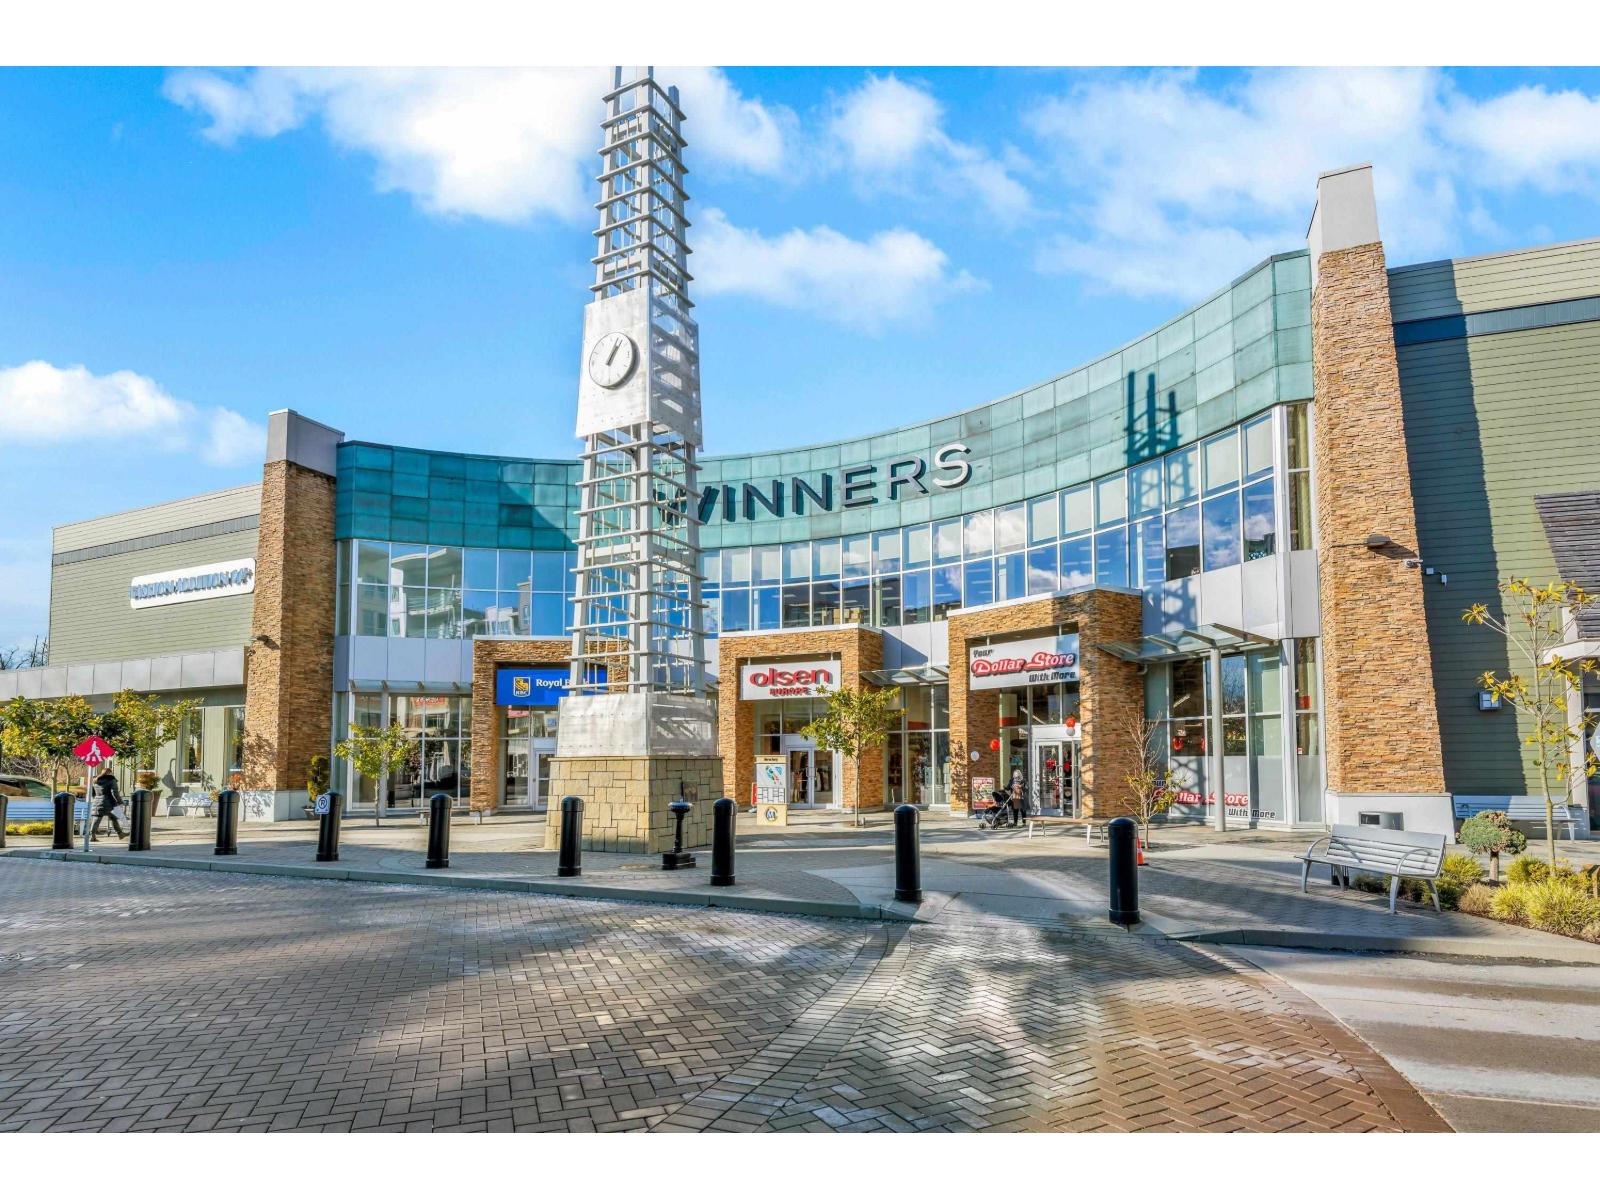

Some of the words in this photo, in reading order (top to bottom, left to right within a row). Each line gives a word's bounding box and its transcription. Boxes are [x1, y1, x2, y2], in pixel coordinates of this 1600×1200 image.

[652, 443, 971, 526] WINNERS
[973, 648, 993, 658] Your
[971, 659, 1025, 676] Dollar
[1025, 652, 1076, 671] Store
[749, 668, 832, 687] olsen
[1029, 672, 1049, 683] With
[1051, 671, 1076, 681] More
[536, 678, 562, 689] Royal
[1251, 809, 1276, 819] More
